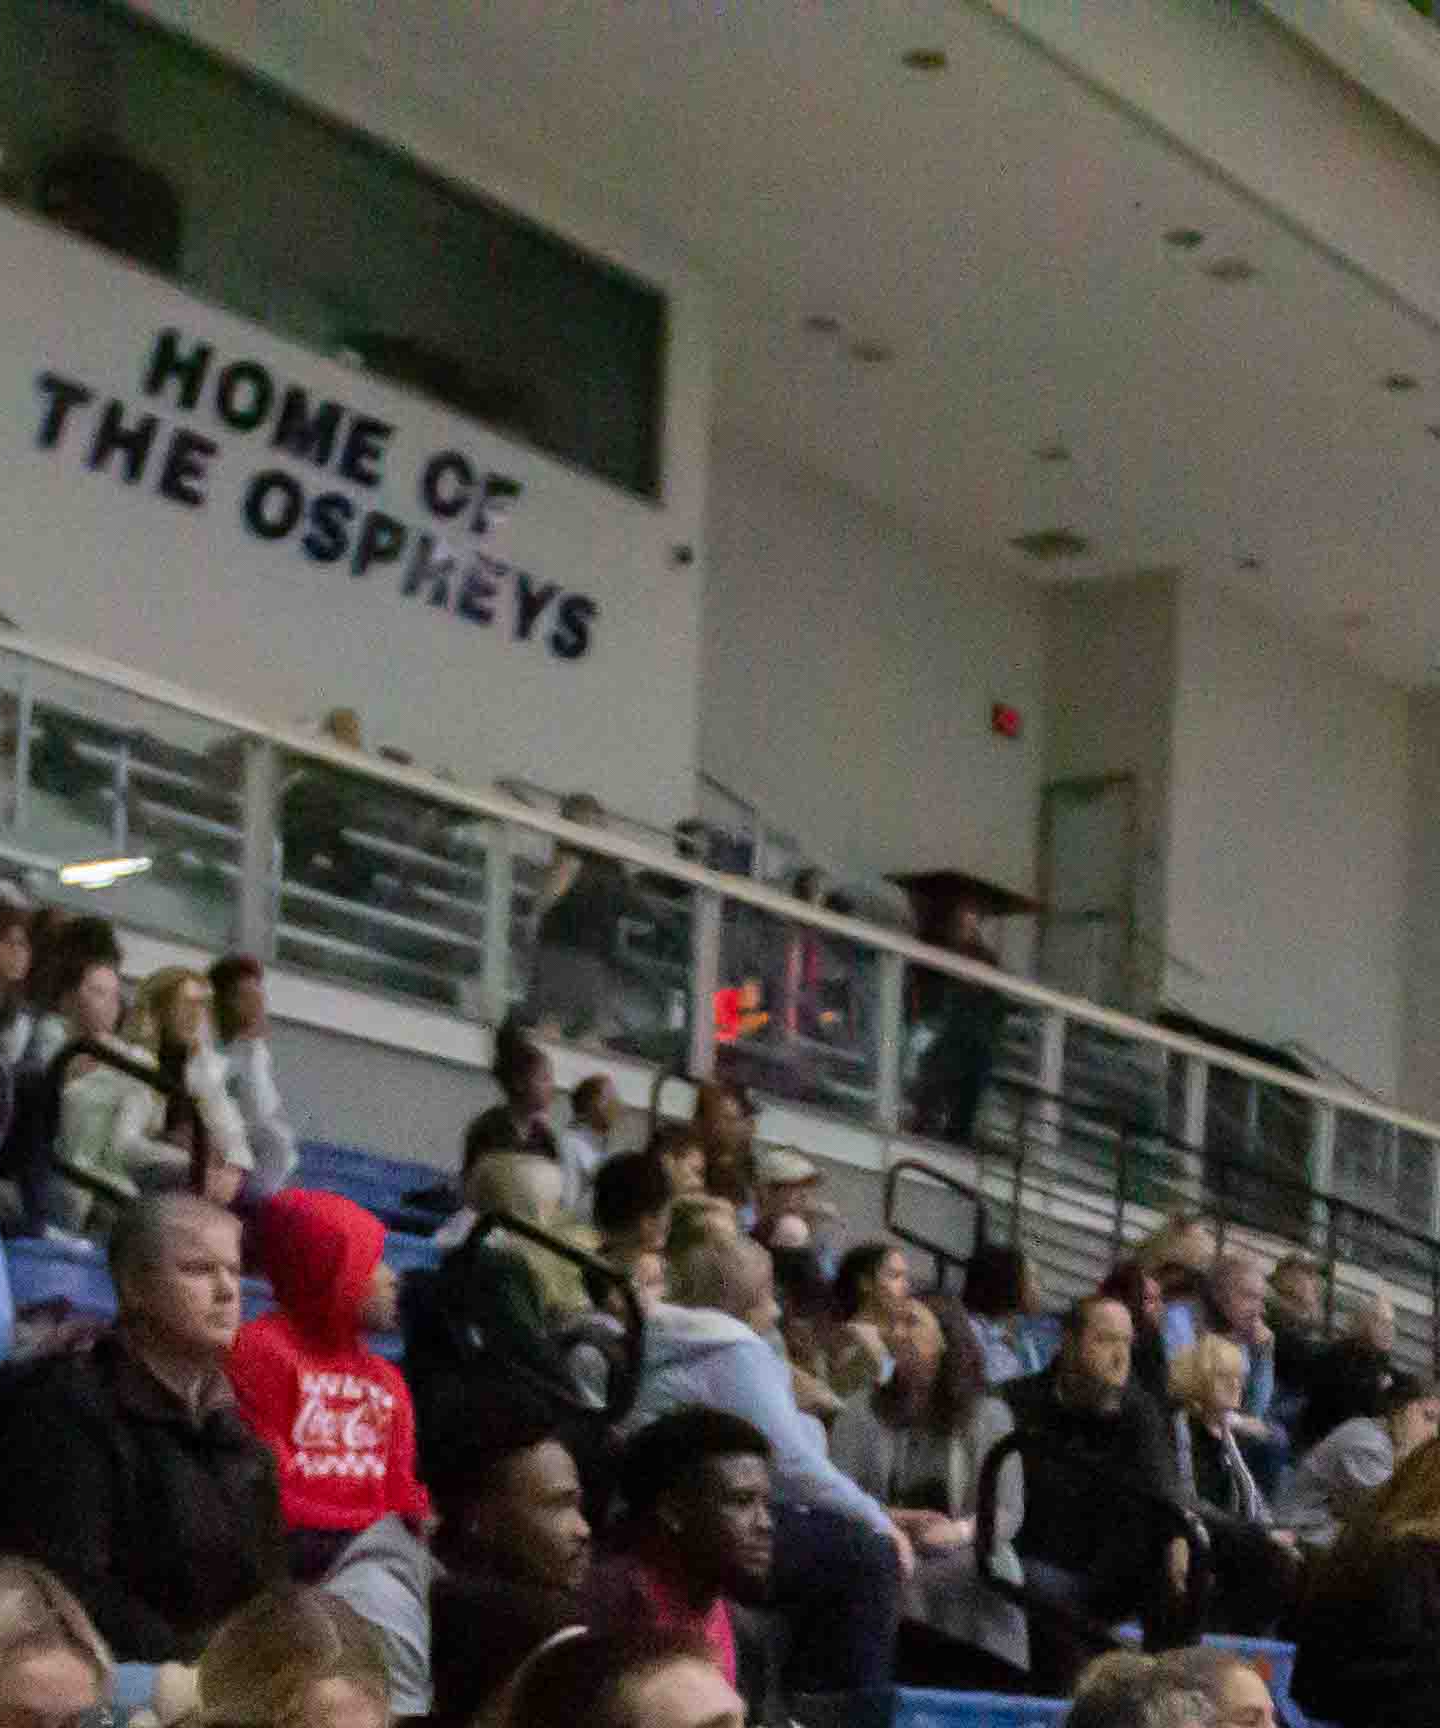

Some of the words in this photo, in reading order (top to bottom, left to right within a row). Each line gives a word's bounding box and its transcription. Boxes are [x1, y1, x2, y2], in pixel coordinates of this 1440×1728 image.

[34, 370, 219, 506] THE
[144, 326, 394, 489] HOME
[422, 448, 524, 534] OF
